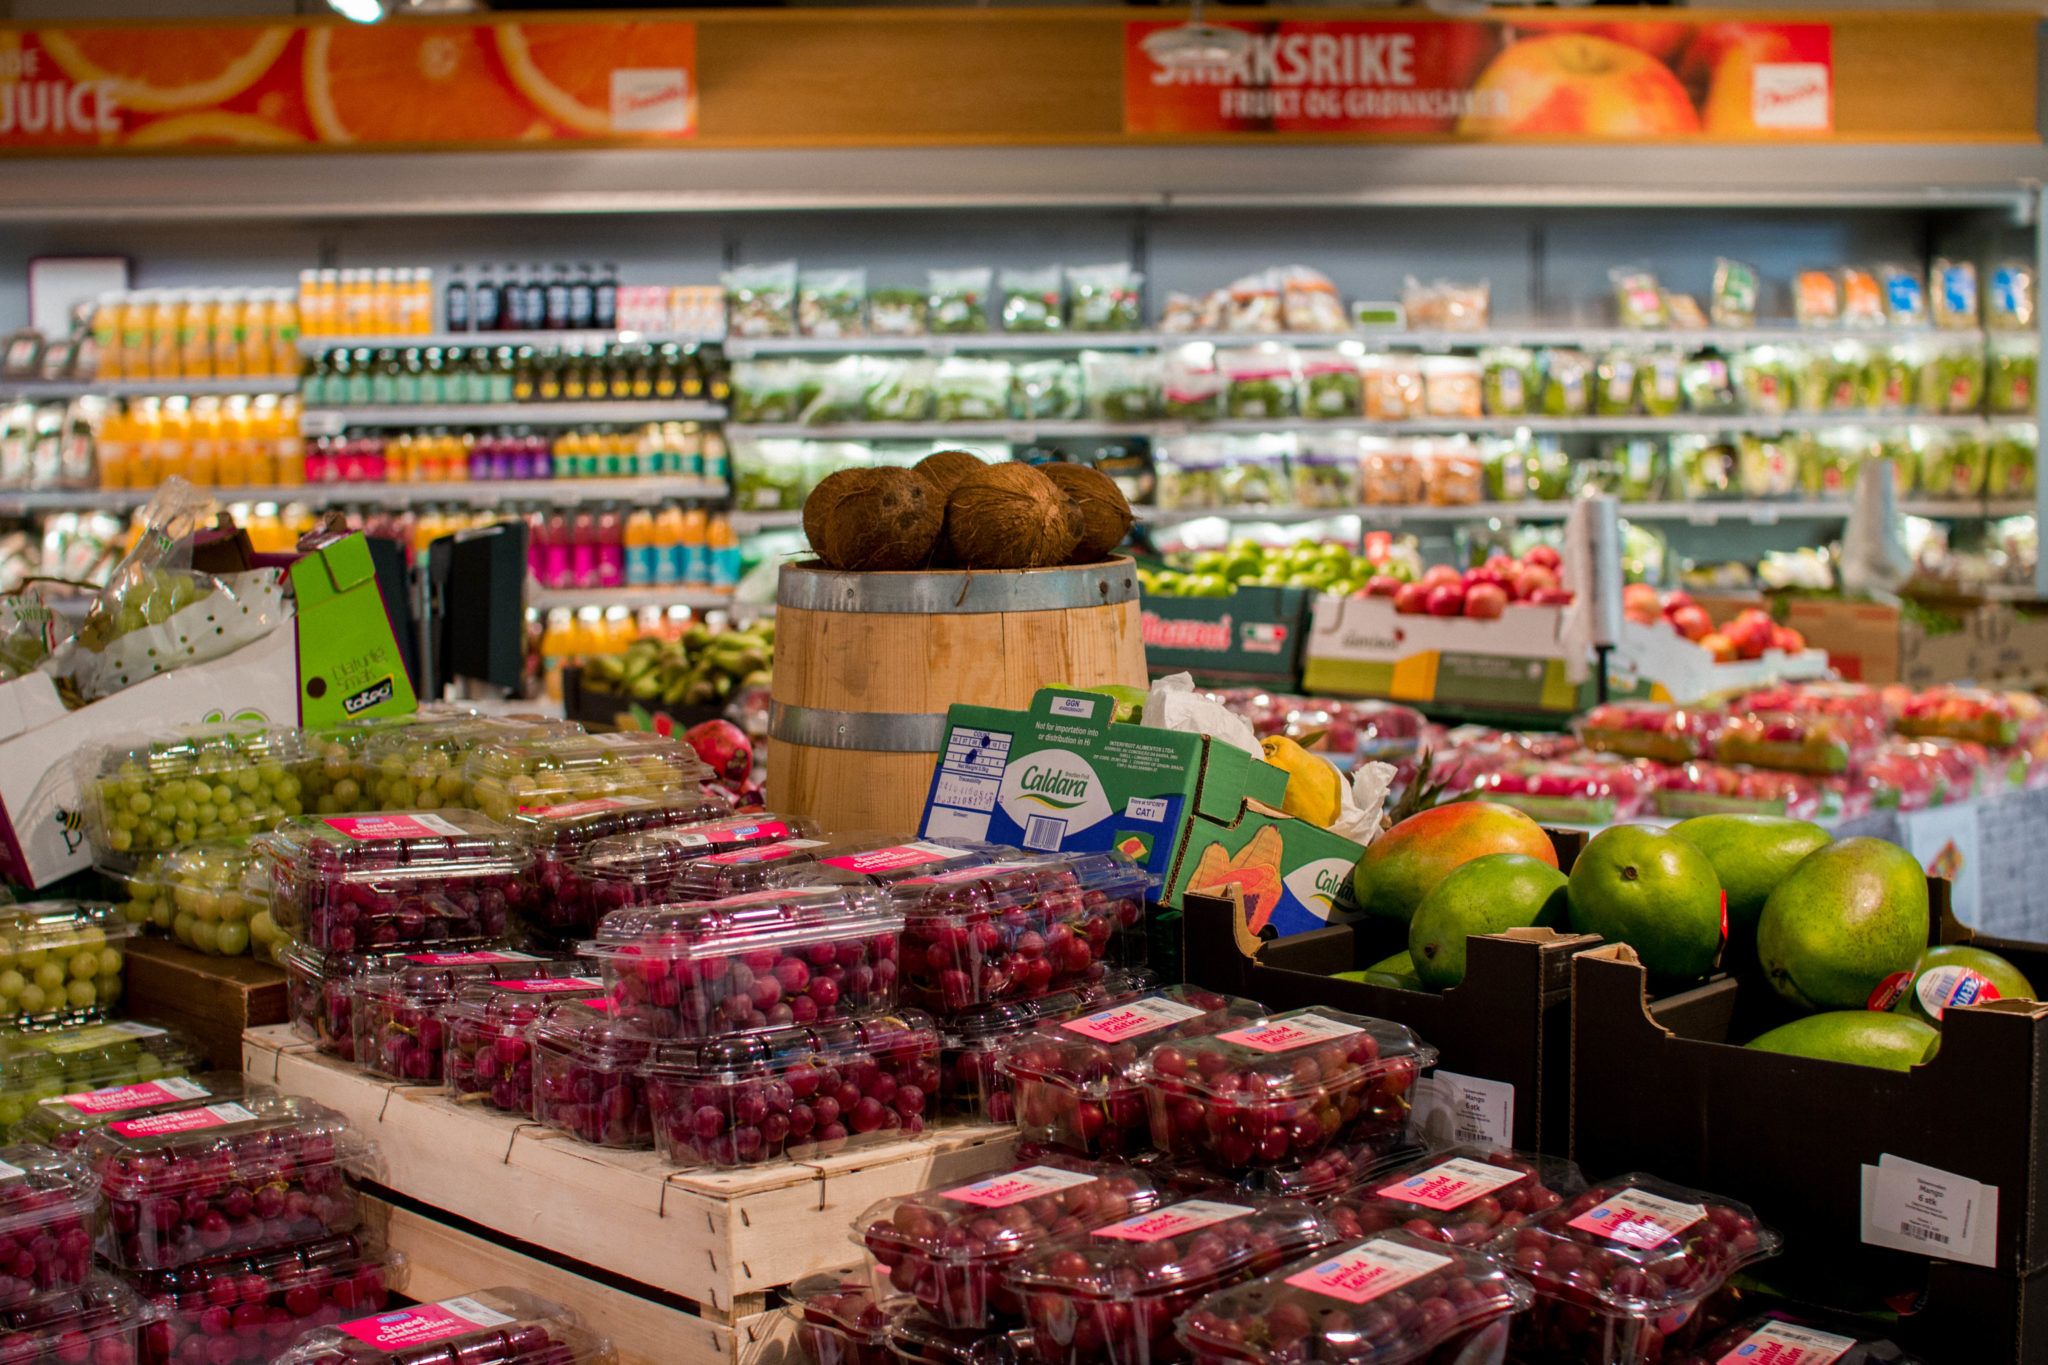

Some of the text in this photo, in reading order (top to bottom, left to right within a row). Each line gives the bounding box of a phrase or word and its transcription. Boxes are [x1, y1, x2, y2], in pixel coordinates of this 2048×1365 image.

[1035, 721, 1099, 737] Not for importation into
[1045, 732, 1077, 744] distribution
[1020, 765, 1088, 798] Caldara
[1135, 807, 1151, 817] CAT
[853, 851, 919, 868] Celebration
[854, 850, 895, 864] Sweet
[1088, 1011, 1136, 1031] Limited
[1103, 1016, 1148, 1035] Edition
[1245, 1026, 1291, 1042] Limited
[1262, 1031, 1305, 1046] Edition
[1465, 1093, 1485, 1103] Mango
[126, 1110, 204, 1131] Celebration
[1407, 1175, 1452, 1198] Limited
[1426, 1180, 1468, 1201] Edition
[1919, 1185, 1945, 1199] Mango
[1918, 1194, 1924, 1202] 6
[1320, 1259, 1369, 1287] Limited
[1341, 1266, 1388, 1292] Edition
[376, 1318, 455, 1342] Celebration
[380, 1315, 428, 1334] Sweet
